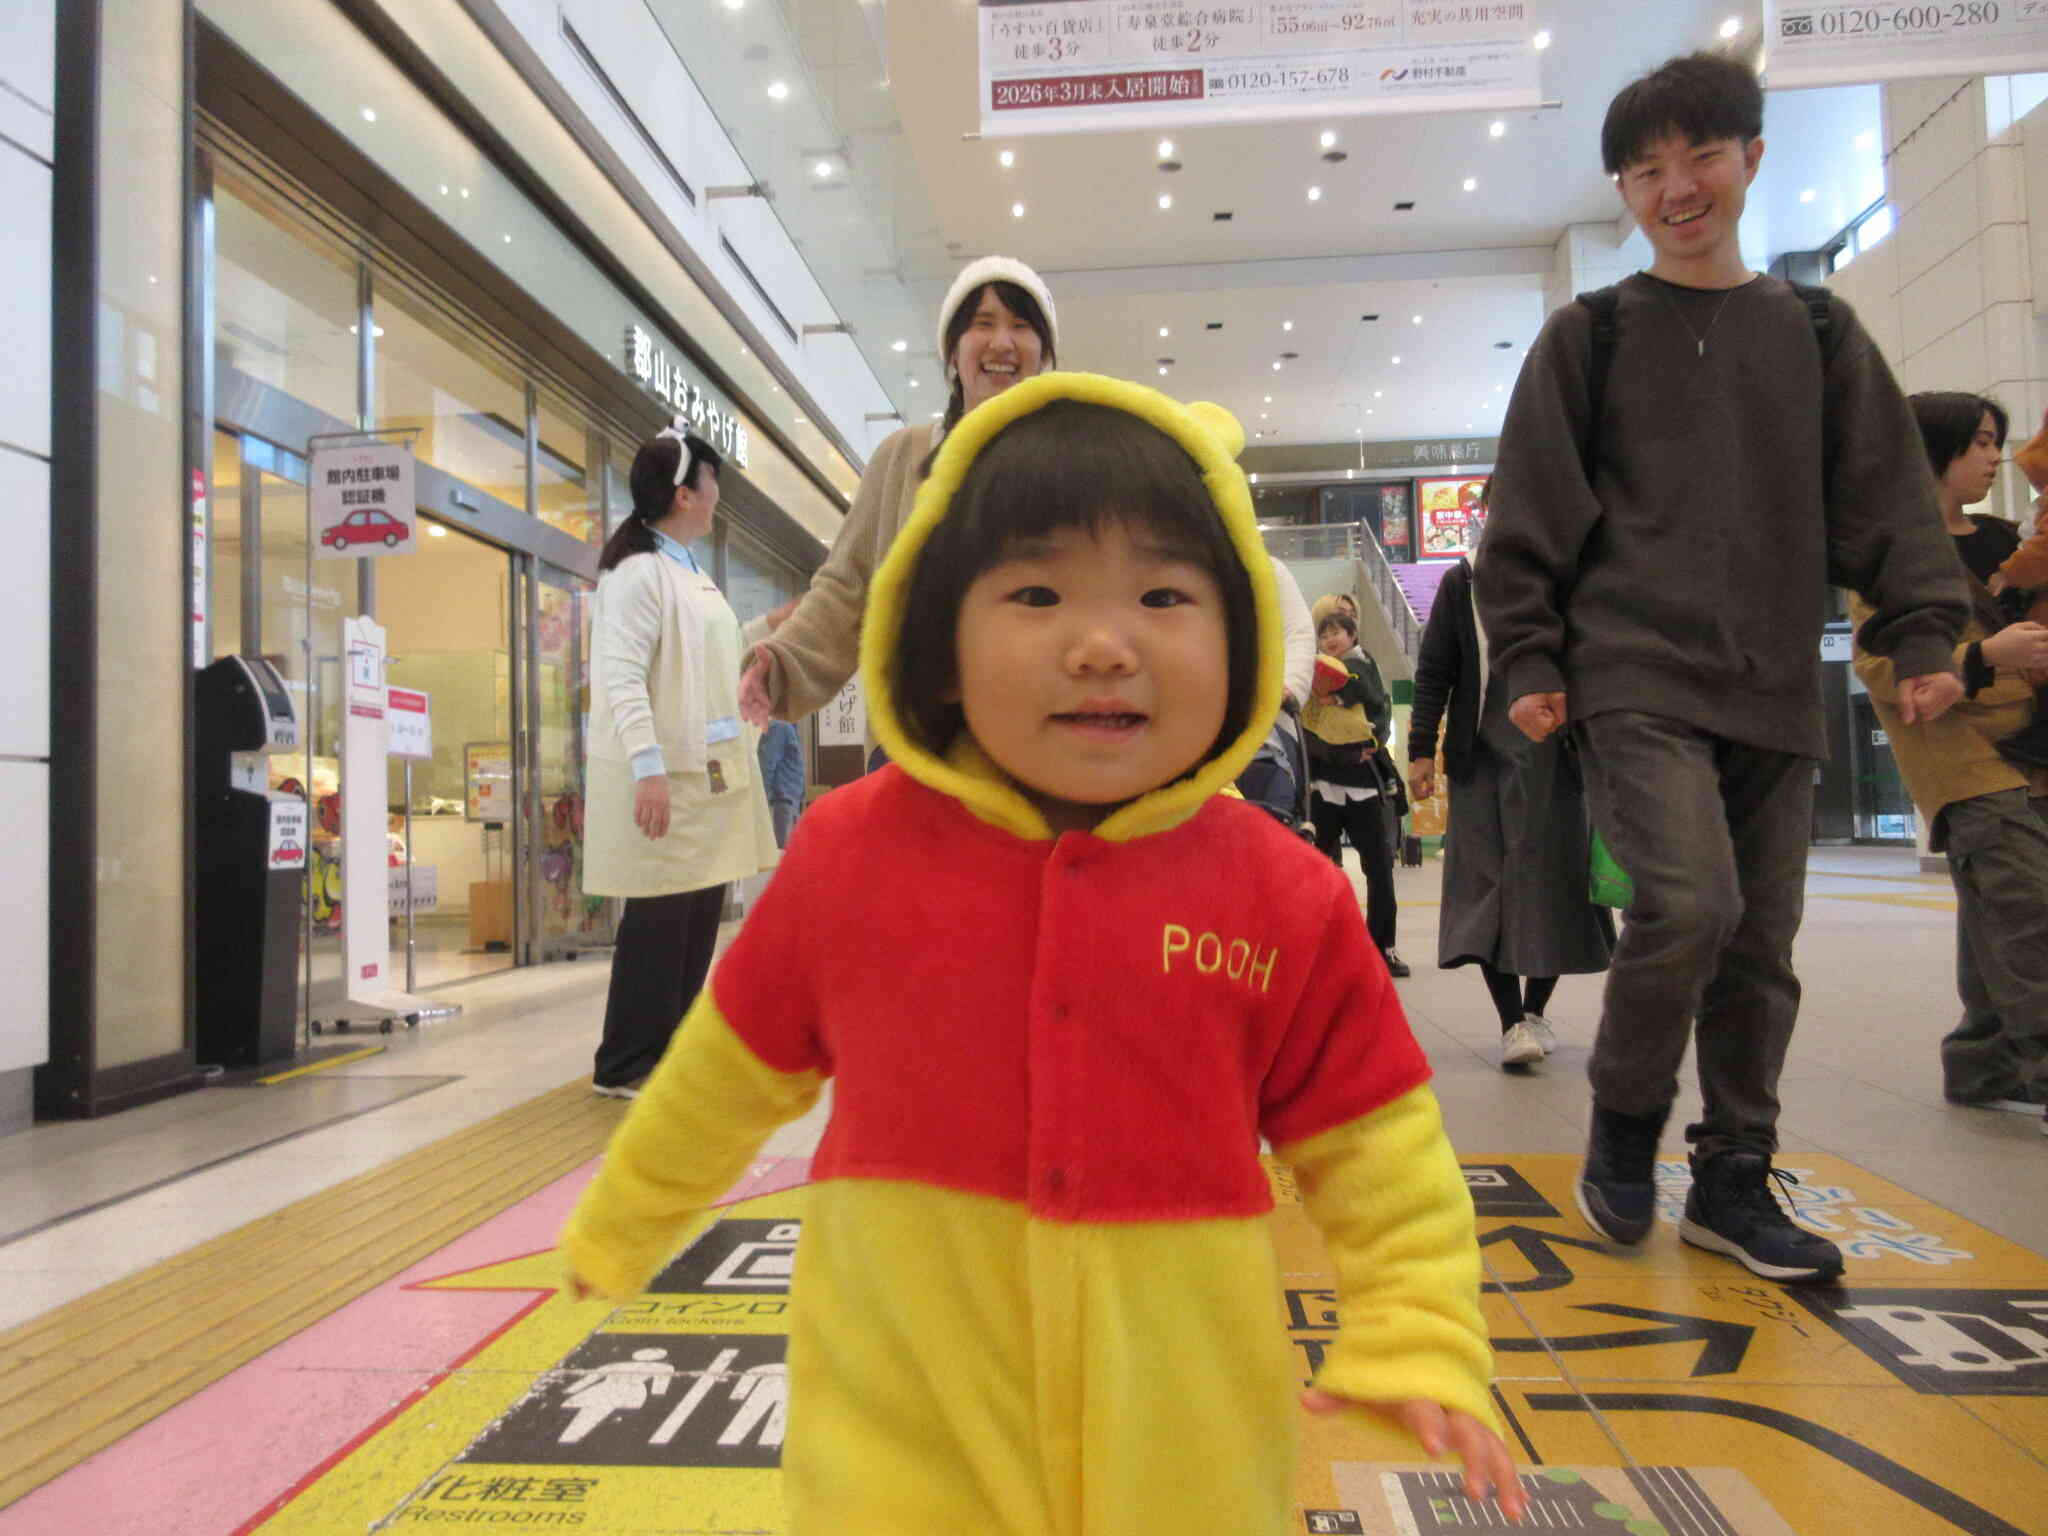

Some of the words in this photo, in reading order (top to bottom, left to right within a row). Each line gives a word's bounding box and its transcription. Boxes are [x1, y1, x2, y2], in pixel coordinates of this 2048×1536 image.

[1820, 1, 1999, 35] 0120-600-280
[1227, 67, 1350, 90] 0120-157-678
[633, 325, 749, 469] 郡山おみやげ館
[1163, 923, 1279, 993] POOH
[1772, 1166, 1975, 1265] うこそ
[1727, 1285, 1812, 1339] タクシー
[421, 1474, 599, 1503] 化粧室
[396, 1504, 588, 1526] Restrooms
